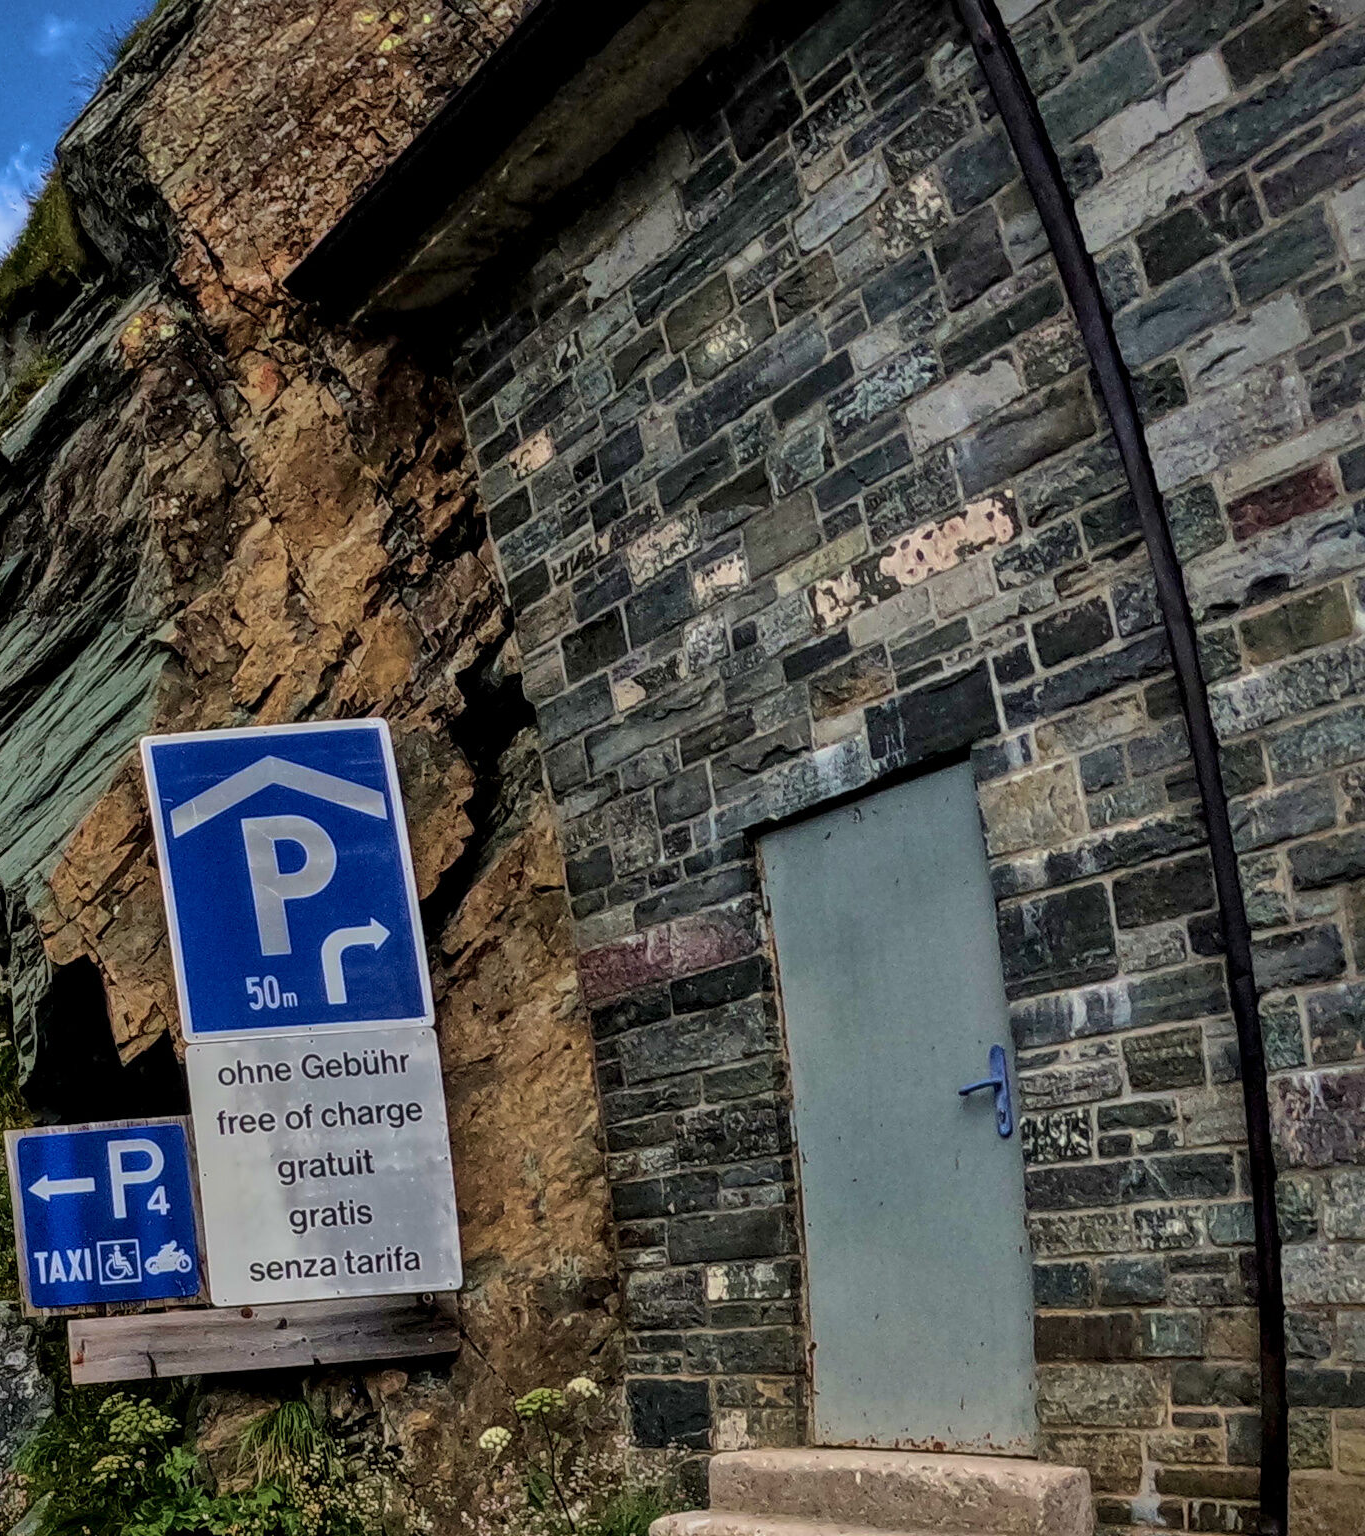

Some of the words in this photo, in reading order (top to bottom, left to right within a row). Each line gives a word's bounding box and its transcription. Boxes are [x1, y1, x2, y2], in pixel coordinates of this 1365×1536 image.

[241, 815, 337, 956] P
[218, 1060, 292, 1087] ohne
[301, 1050, 410, 1080] Gebühr
[216, 1110, 276, 1135] free
[285, 1104, 313, 1130] of
[321, 1101, 423, 1128] charge
[277, 1149, 375, 1185] gratuit
[289, 1199, 373, 1234] gratis
[34, 1248, 93, 1284] TAXI
[249, 1256, 336, 1282] senza
[344, 1246, 421, 1275] tarifa
